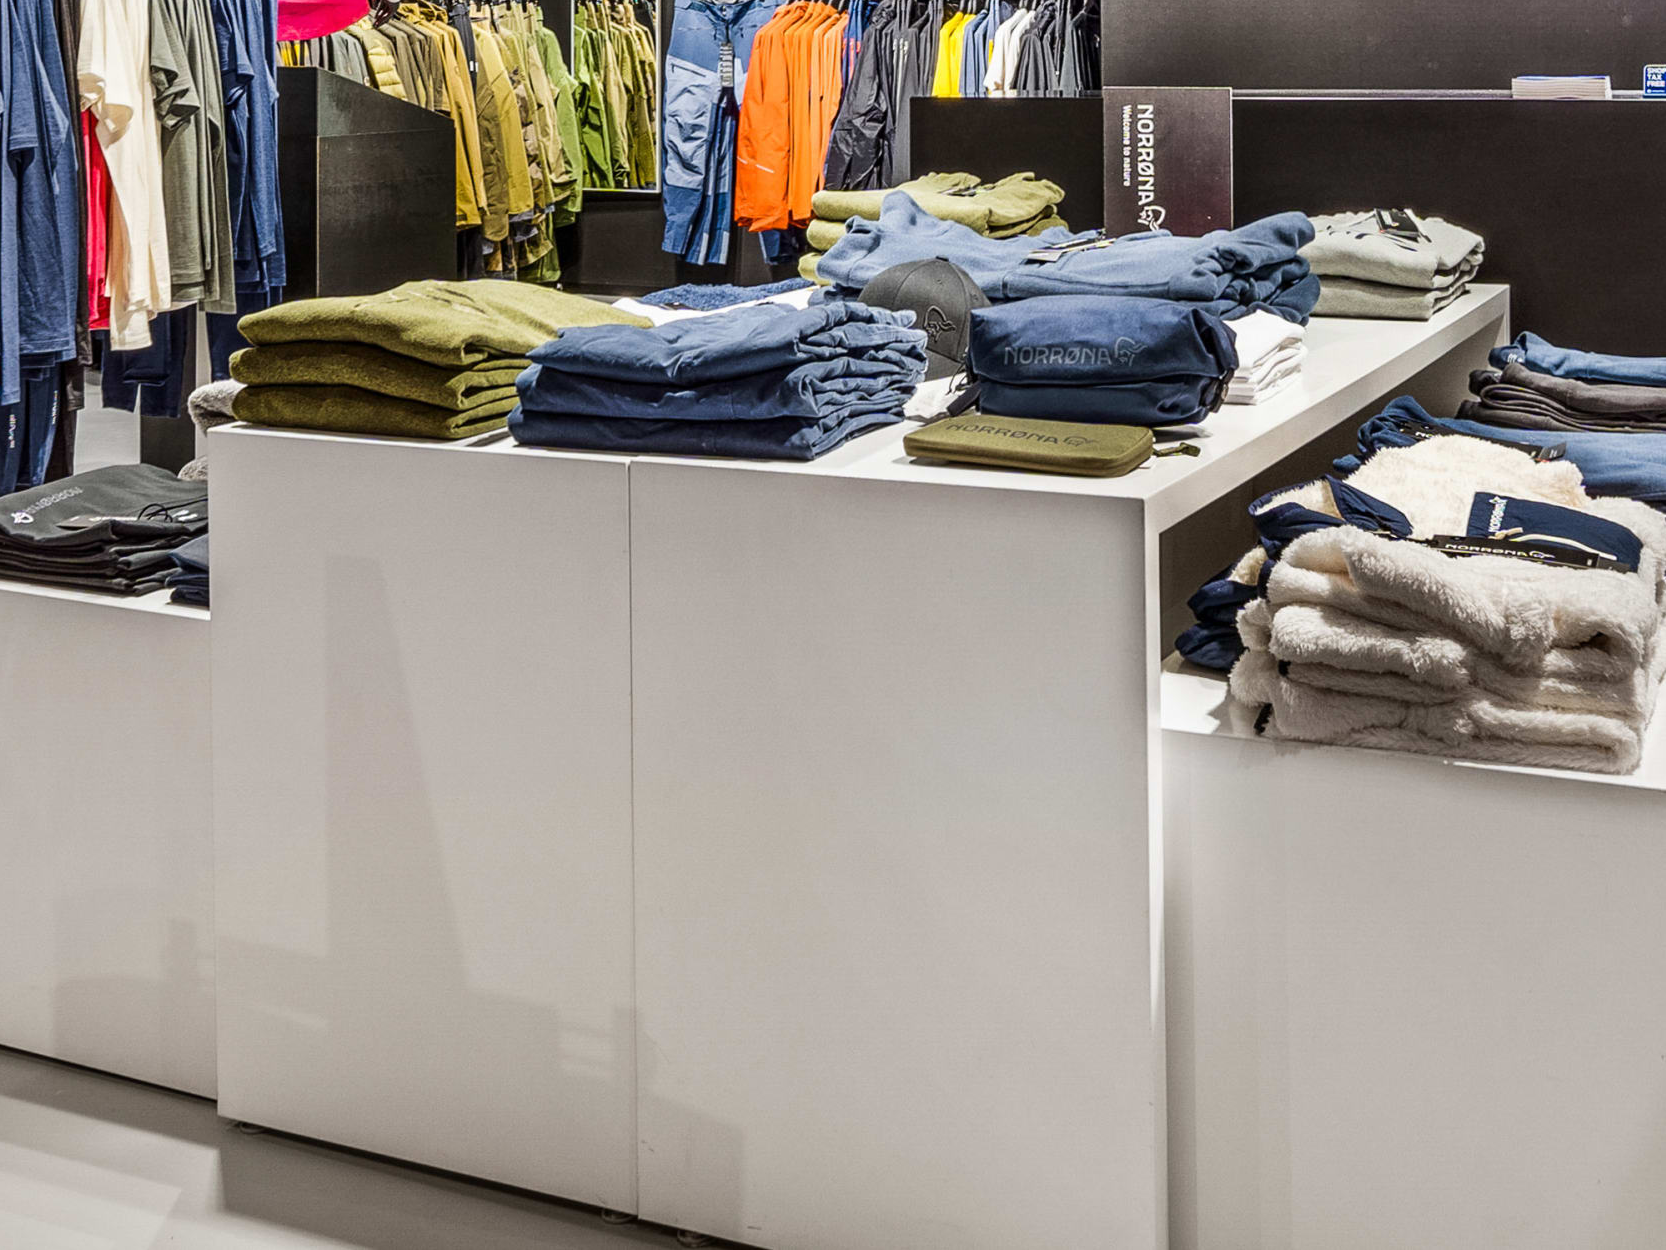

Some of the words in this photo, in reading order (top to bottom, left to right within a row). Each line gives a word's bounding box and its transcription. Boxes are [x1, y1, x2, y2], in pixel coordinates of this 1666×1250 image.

[1646, 73, 1663, 81] TAX
[1122, 104, 1132, 146] Welcome
[1122, 146, 1132, 156] to
[1136, 104, 1155, 206] NORRØNA
[1122, 157, 1132, 187] nature
[1003, 346, 1112, 366] NORRØNA
[946, 423, 1059, 445] NORRØNA
